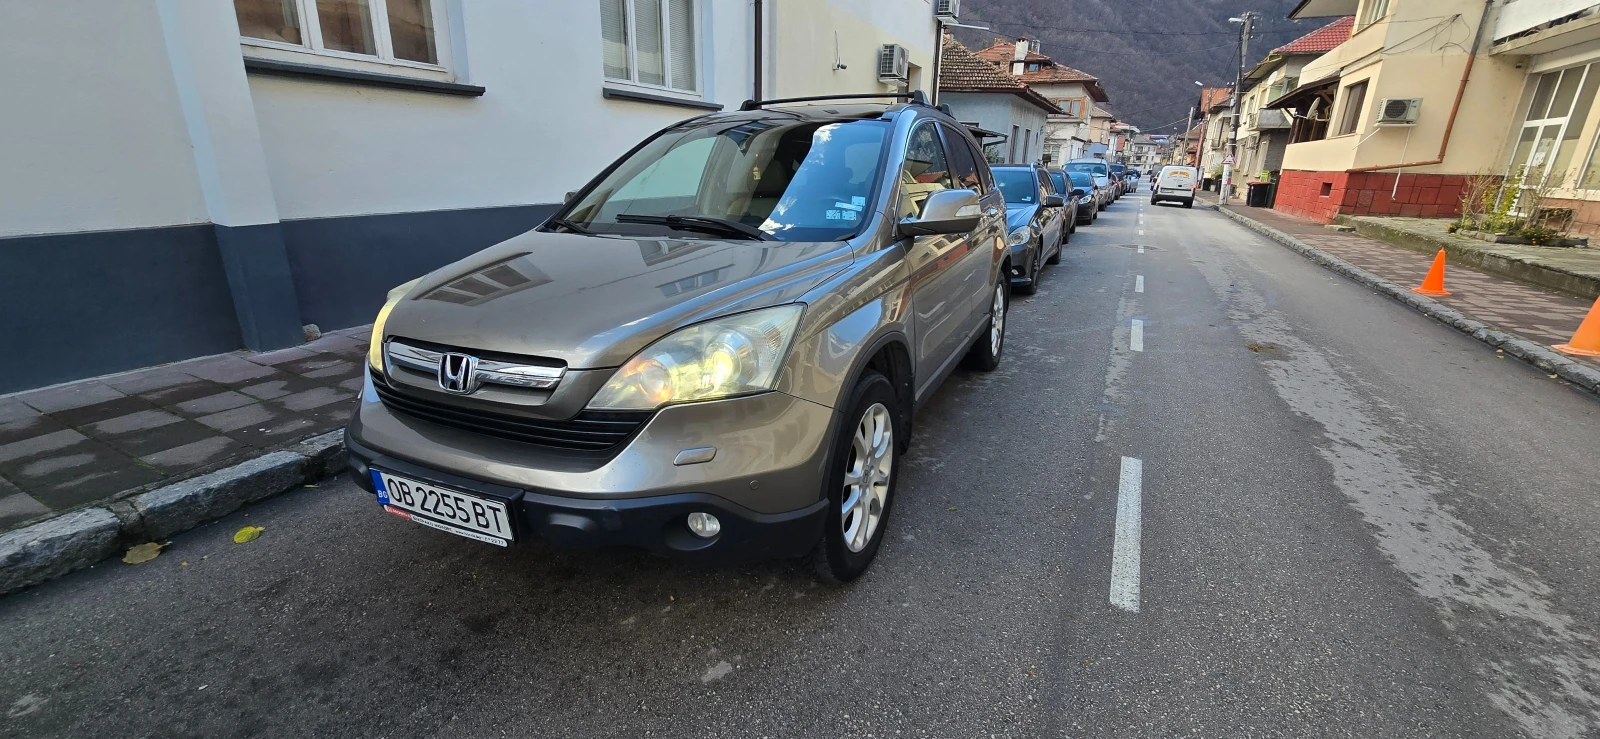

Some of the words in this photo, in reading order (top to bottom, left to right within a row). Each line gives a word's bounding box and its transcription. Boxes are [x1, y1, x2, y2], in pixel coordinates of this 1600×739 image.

[378, 490, 388, 499] BG
[388, 479, 415, 508] OB
[416, 487, 471, 524] 2255
[472, 500, 503, 533] BT
